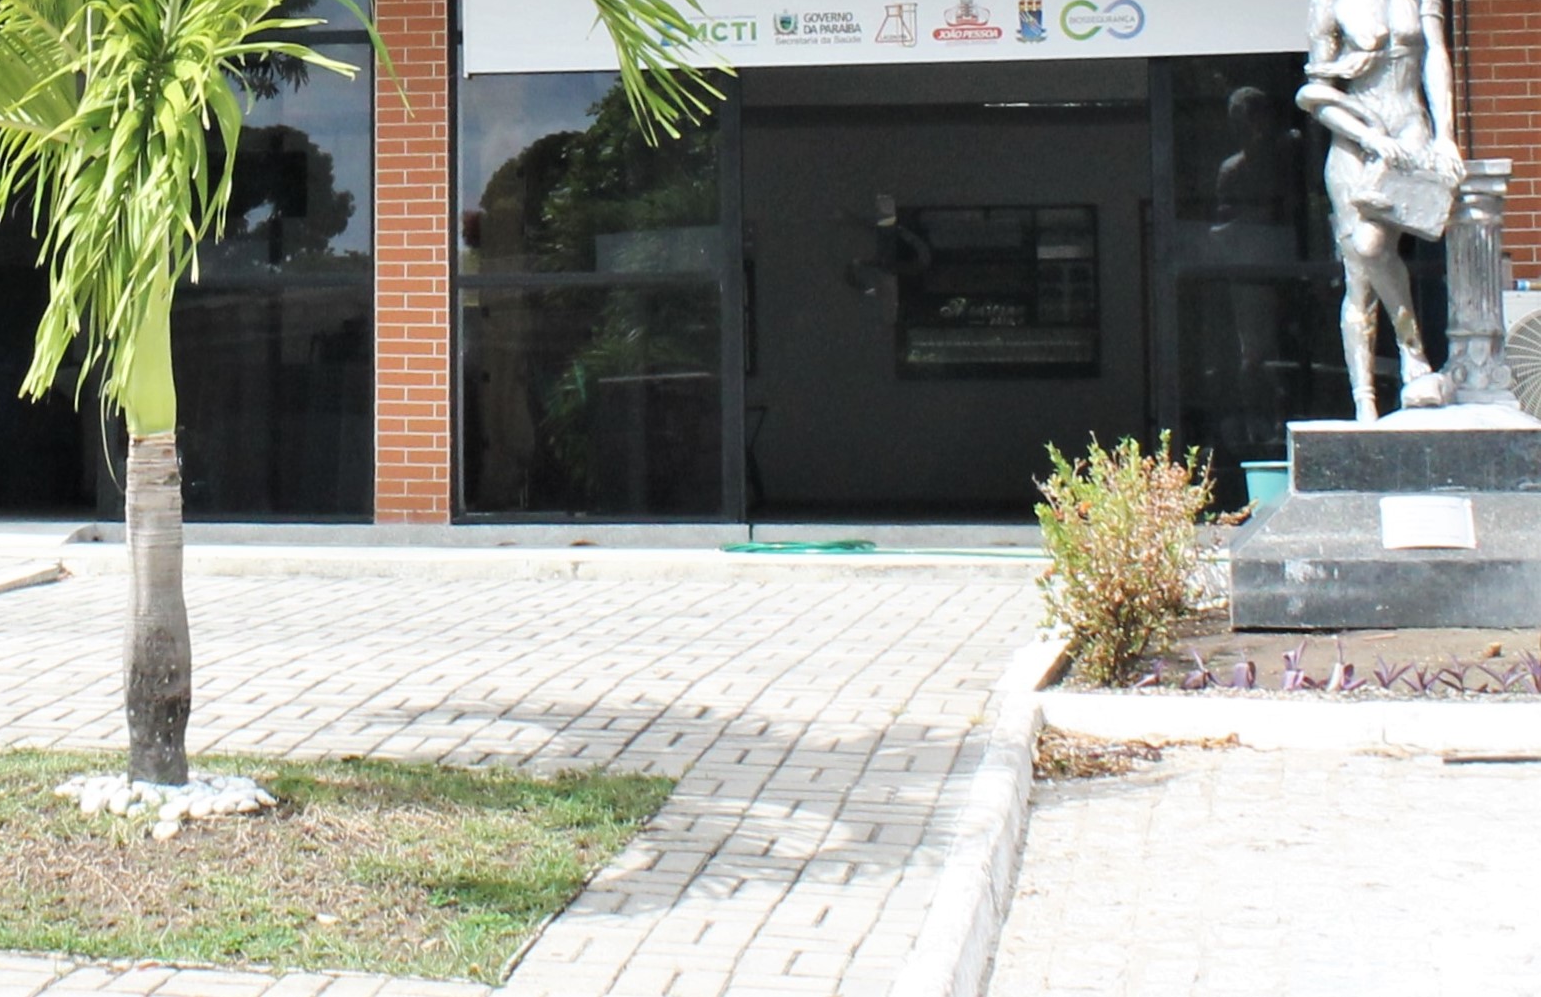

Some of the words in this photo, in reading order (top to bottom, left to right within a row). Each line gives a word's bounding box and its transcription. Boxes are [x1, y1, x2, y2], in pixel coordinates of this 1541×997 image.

[803, 12, 854, 23] GOVERNO
[687, 21, 757, 42] MCTI
[803, 24, 818, 35] DA
